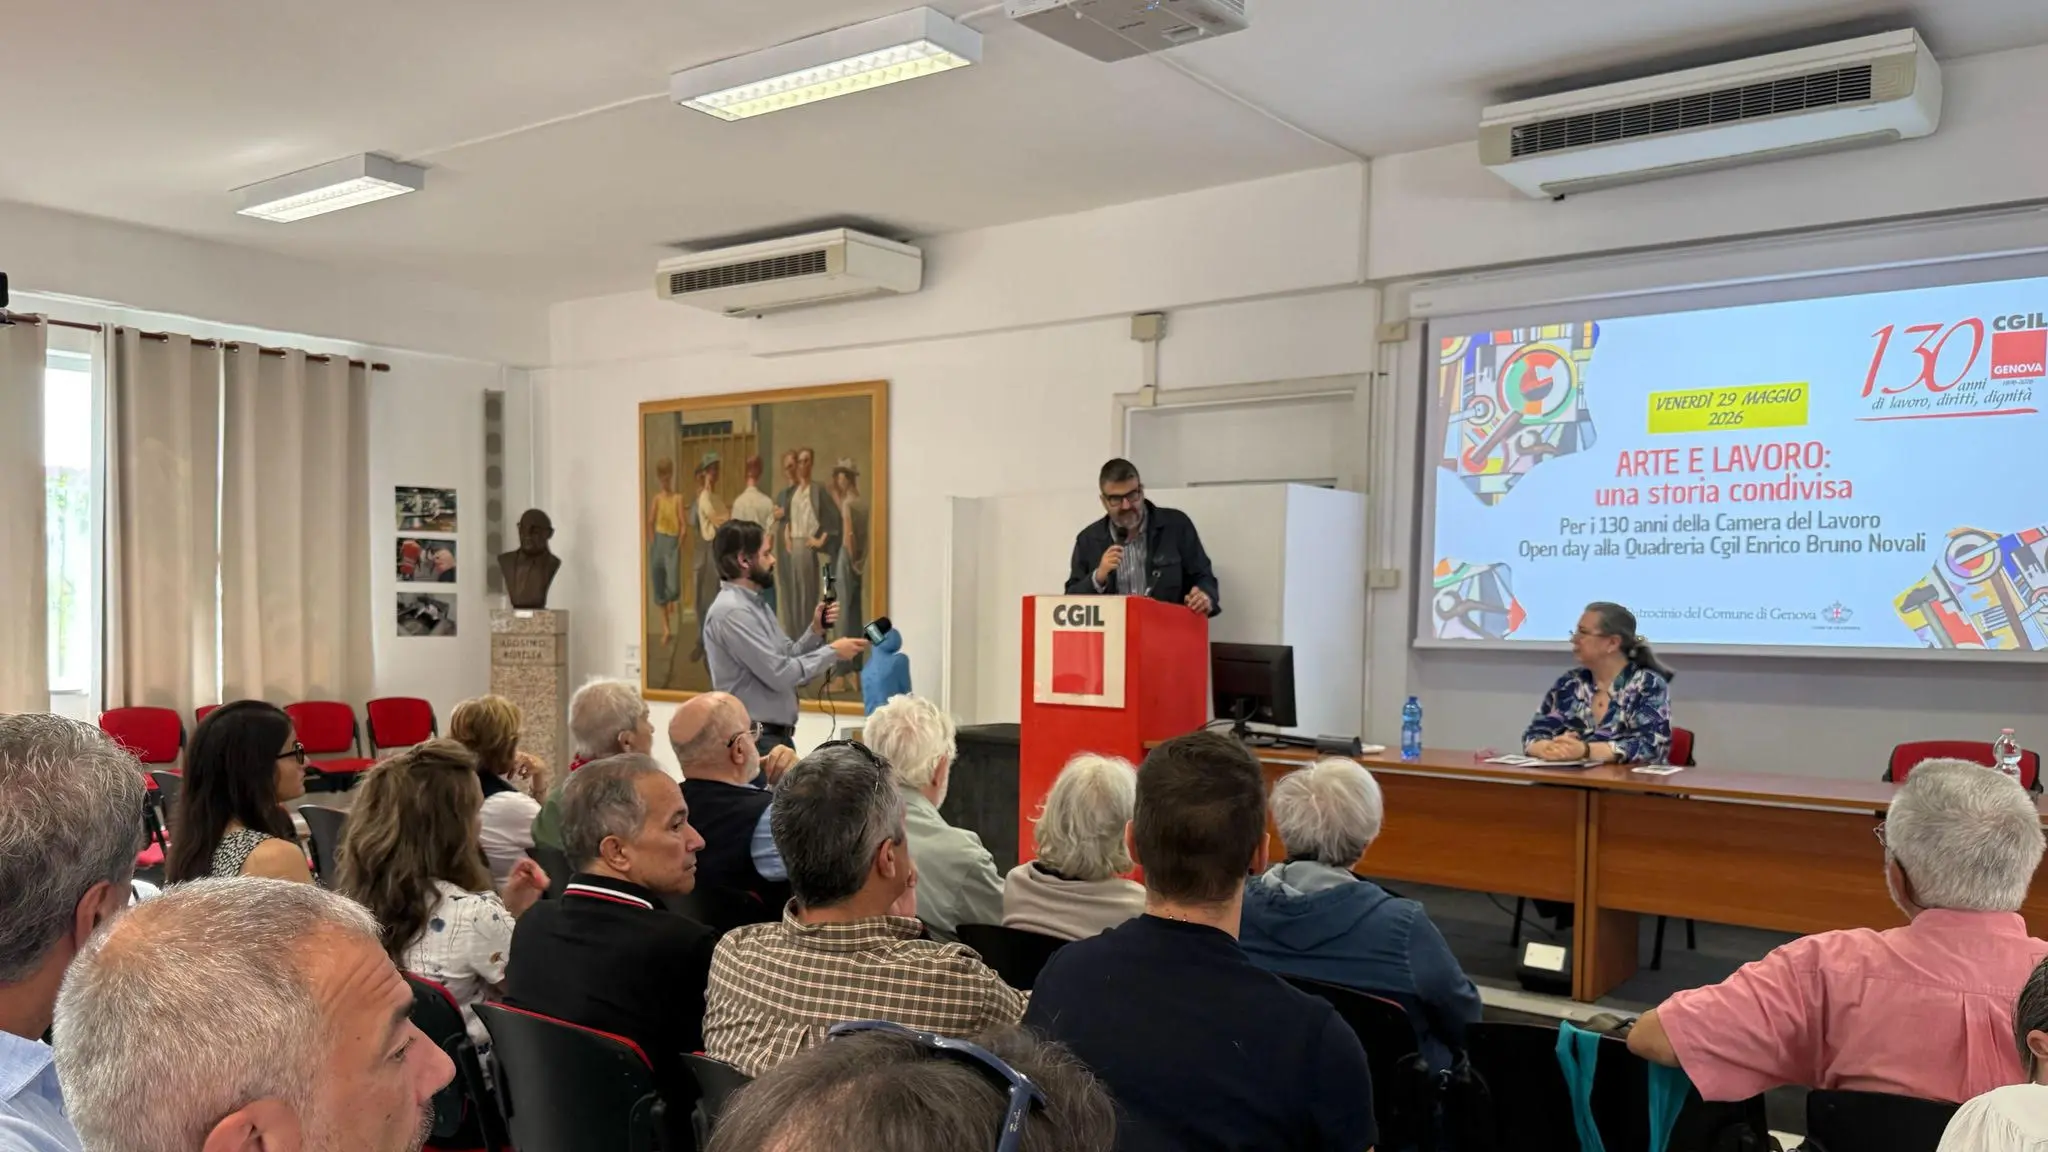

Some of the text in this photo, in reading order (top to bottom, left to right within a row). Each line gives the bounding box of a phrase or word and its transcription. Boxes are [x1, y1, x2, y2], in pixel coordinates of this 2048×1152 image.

[1992, 312, 2048, 331] CGIL
[1861, 317, 1985, 398] 130
[1993, 362, 2043, 376] GENOVA
[1957, 378, 1987, 392] anni
[1656, 388, 1801, 411] VENERDÌ 29 MAGGIO
[1871, 387, 2033, 410] di lavoro, diritti, dignità
[1707, 410, 1744, 426] 2026
[1616, 441, 1831, 477] ARTE E LAVORO:
[1595, 472, 1853, 507] una storia condivisa
[1560, 510, 1881, 535] Per i 130 anni della Camera del Lavoro
[1519, 532, 1926, 562] Open day alla Quadreria Cgil Enrico Bruno Novali
[1053, 604, 1105, 627] CGIL
[1684, 605, 1701, 619] del
[1703, 606, 1754, 620] Comune
[1756, 606, 1767, 620] di
[1770, 607, 1817, 620] Genova
